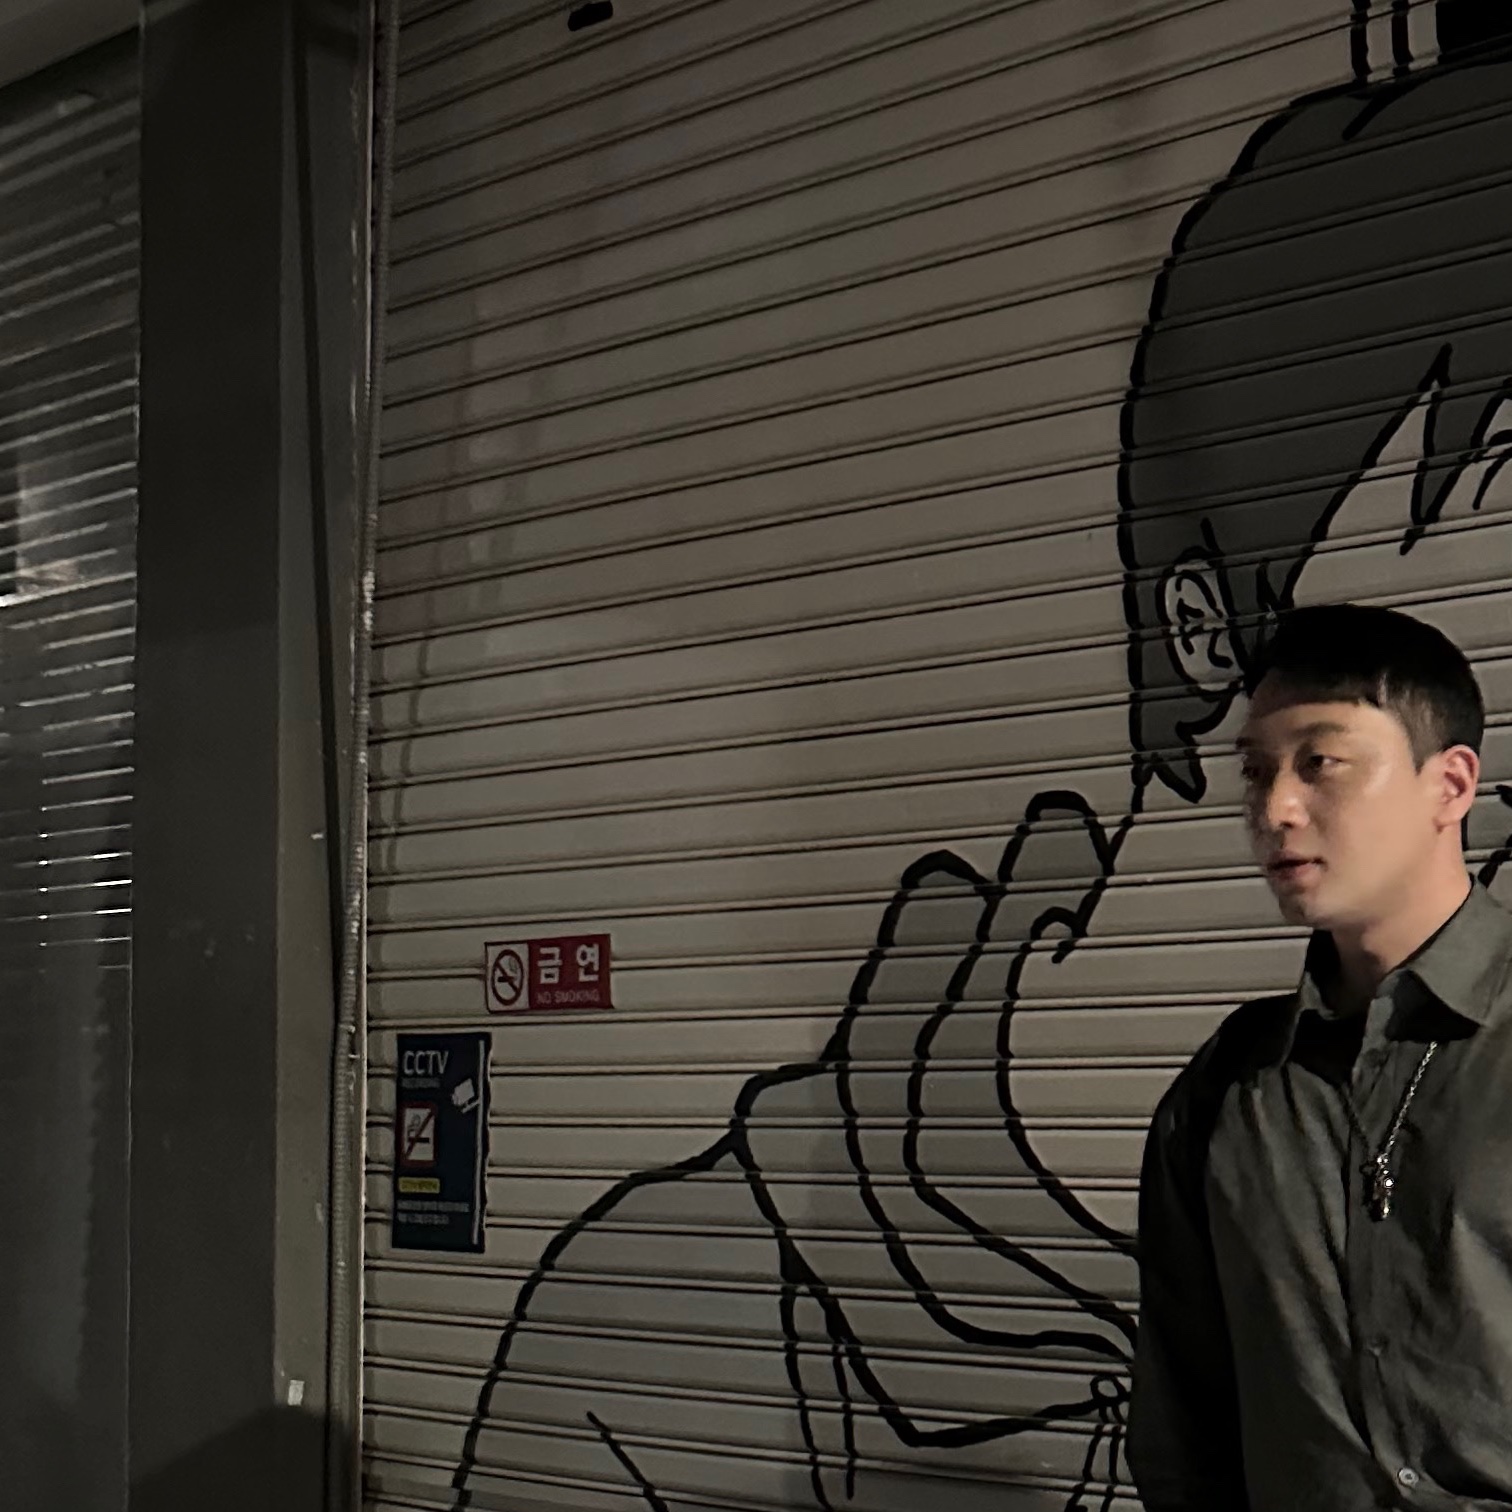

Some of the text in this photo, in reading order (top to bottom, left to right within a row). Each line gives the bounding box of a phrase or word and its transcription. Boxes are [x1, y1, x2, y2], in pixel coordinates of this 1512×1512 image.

[537, 989, 600, 1004] NO SMOKING
[403, 1050, 449, 1075] CCTV
